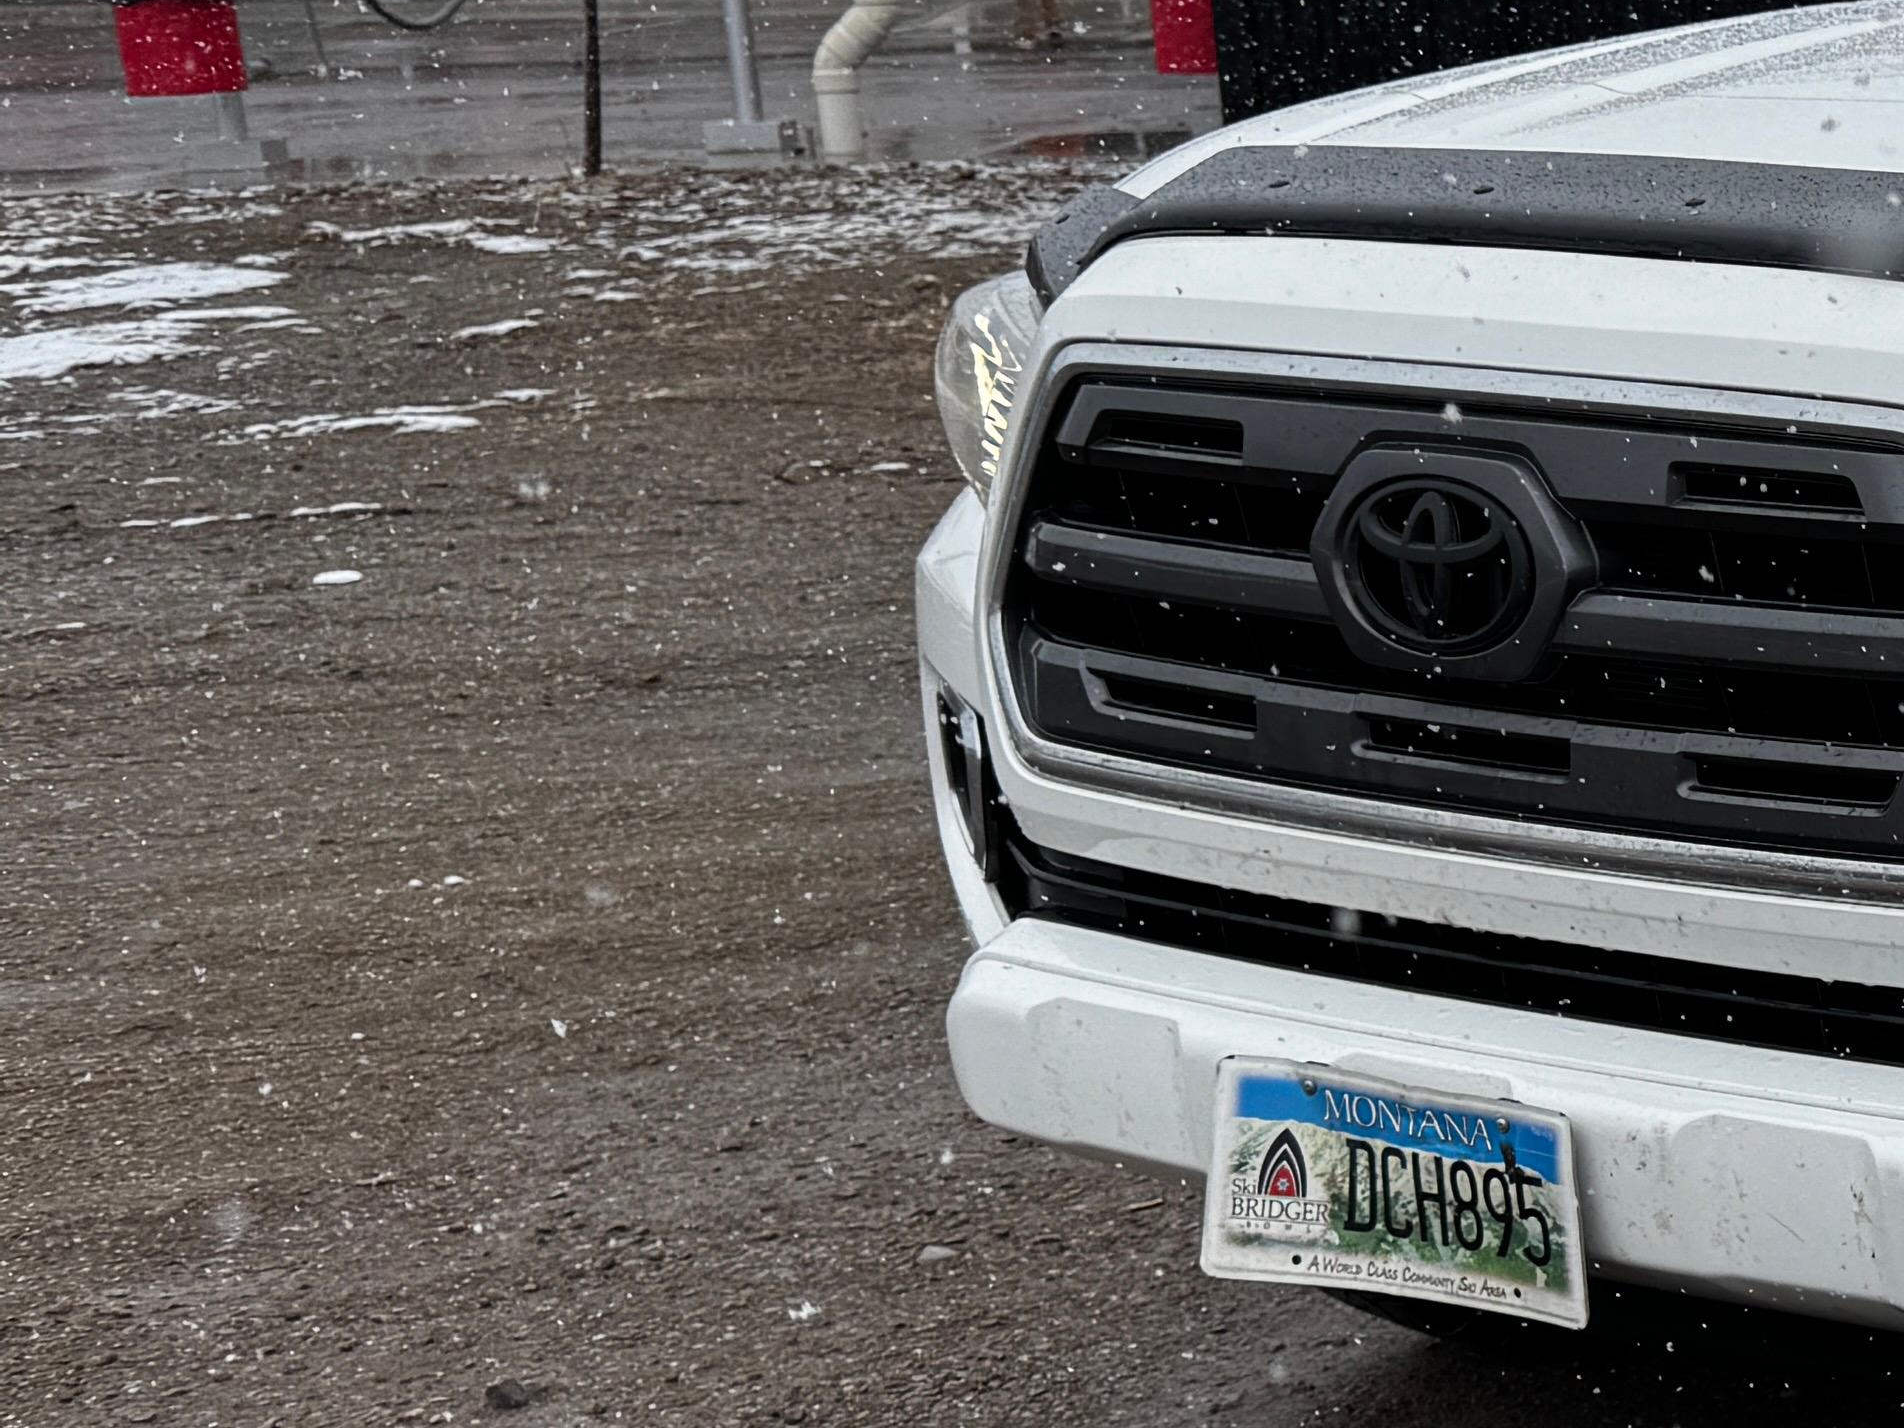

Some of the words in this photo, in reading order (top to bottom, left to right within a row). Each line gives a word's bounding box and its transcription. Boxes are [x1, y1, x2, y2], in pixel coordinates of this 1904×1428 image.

[1323, 1089, 1492, 1152] MONTANA
[1232, 1178, 1258, 1196] Ski
[1231, 1196, 1329, 1223] BRIDGER
[1343, 1138, 1552, 1268] DCH895
[1307, 1254, 1320, 1272] A
